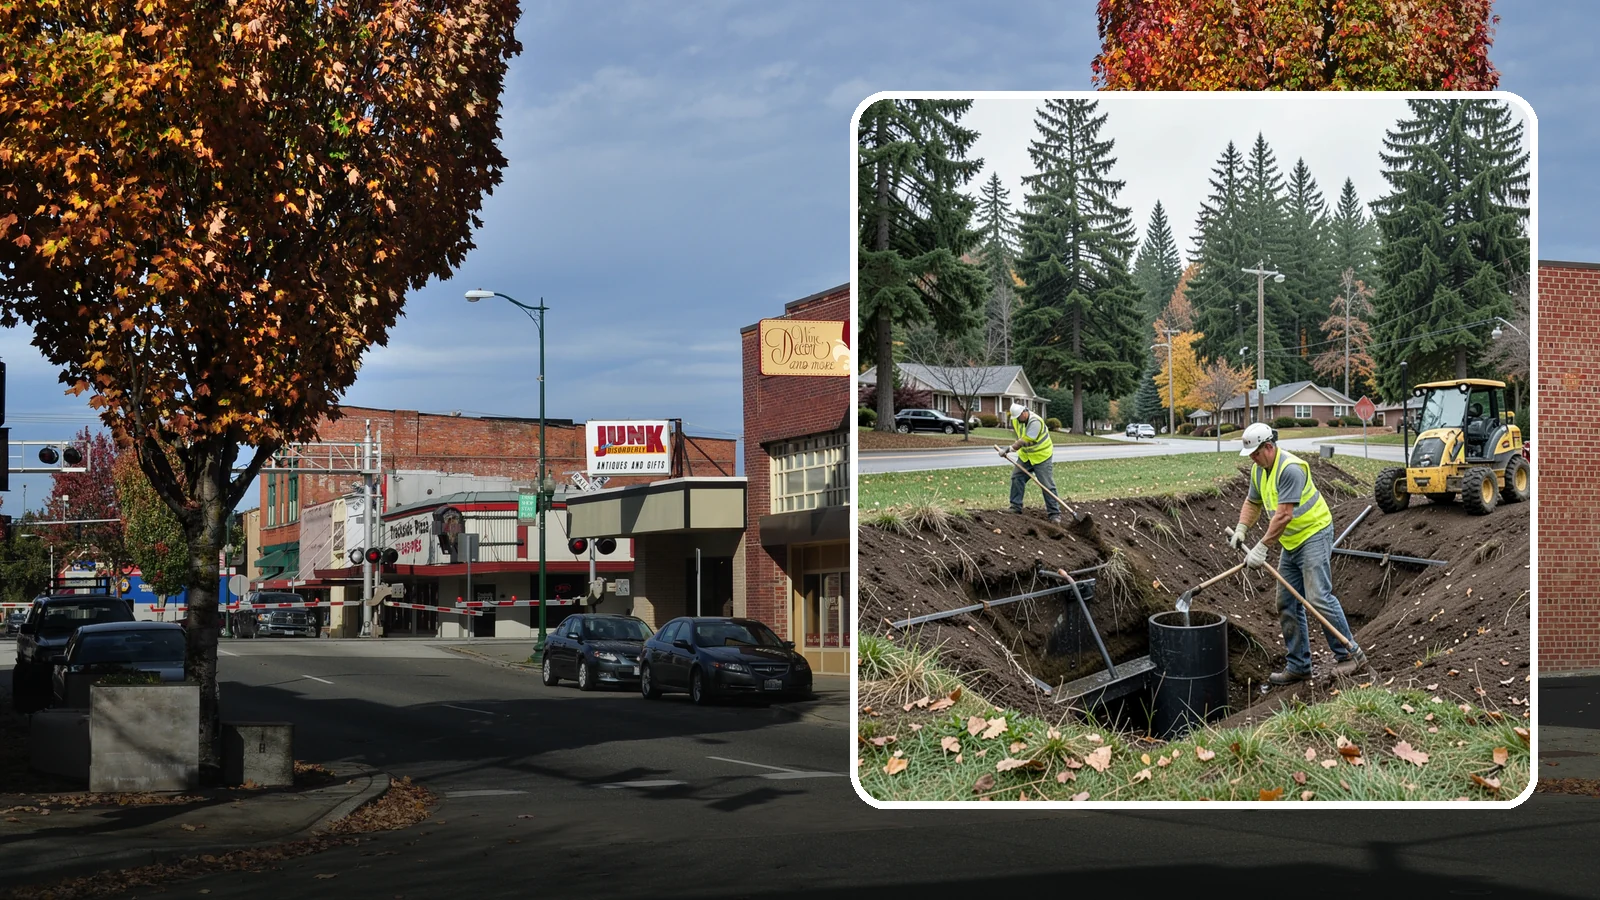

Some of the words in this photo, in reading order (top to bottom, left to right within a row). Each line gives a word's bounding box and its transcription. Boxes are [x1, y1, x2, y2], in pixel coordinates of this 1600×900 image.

[595, 425, 665, 457] JUNK
[607, 446, 646, 454] DISORDERLY
[596, 461, 628, 470] ANTIQUES
[631, 461, 644, 470] AND
[647, 460, 665, 470] GIFTS
[588, 476, 608, 492] SING
[352, 498, 365, 511] CRO
